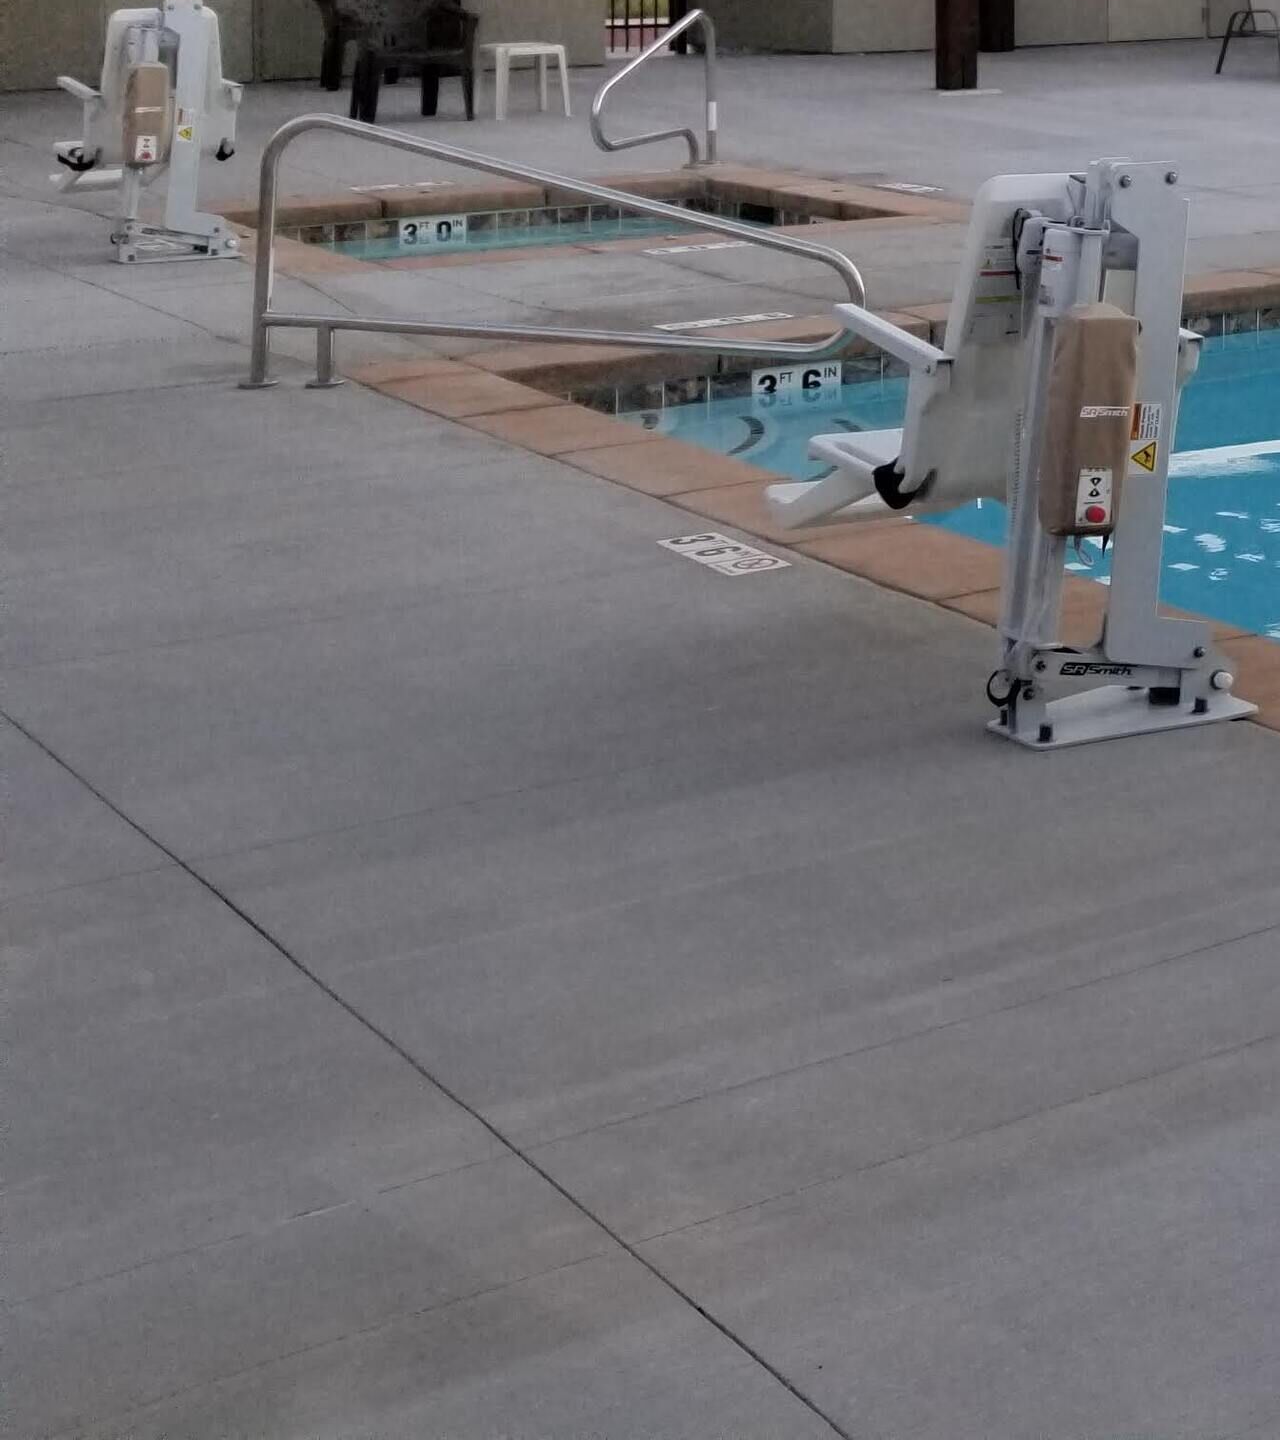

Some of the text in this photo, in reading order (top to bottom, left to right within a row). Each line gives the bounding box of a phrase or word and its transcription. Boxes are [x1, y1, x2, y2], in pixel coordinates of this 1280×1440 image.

[420, 221, 431, 229] FT
[437, 221, 451, 241] 0
[453, 219, 464, 228] IN
[757, 367, 838, 394] 3 FT 6 IN
[668, 535, 716, 545] 3
[695, 546, 742, 557] 6
